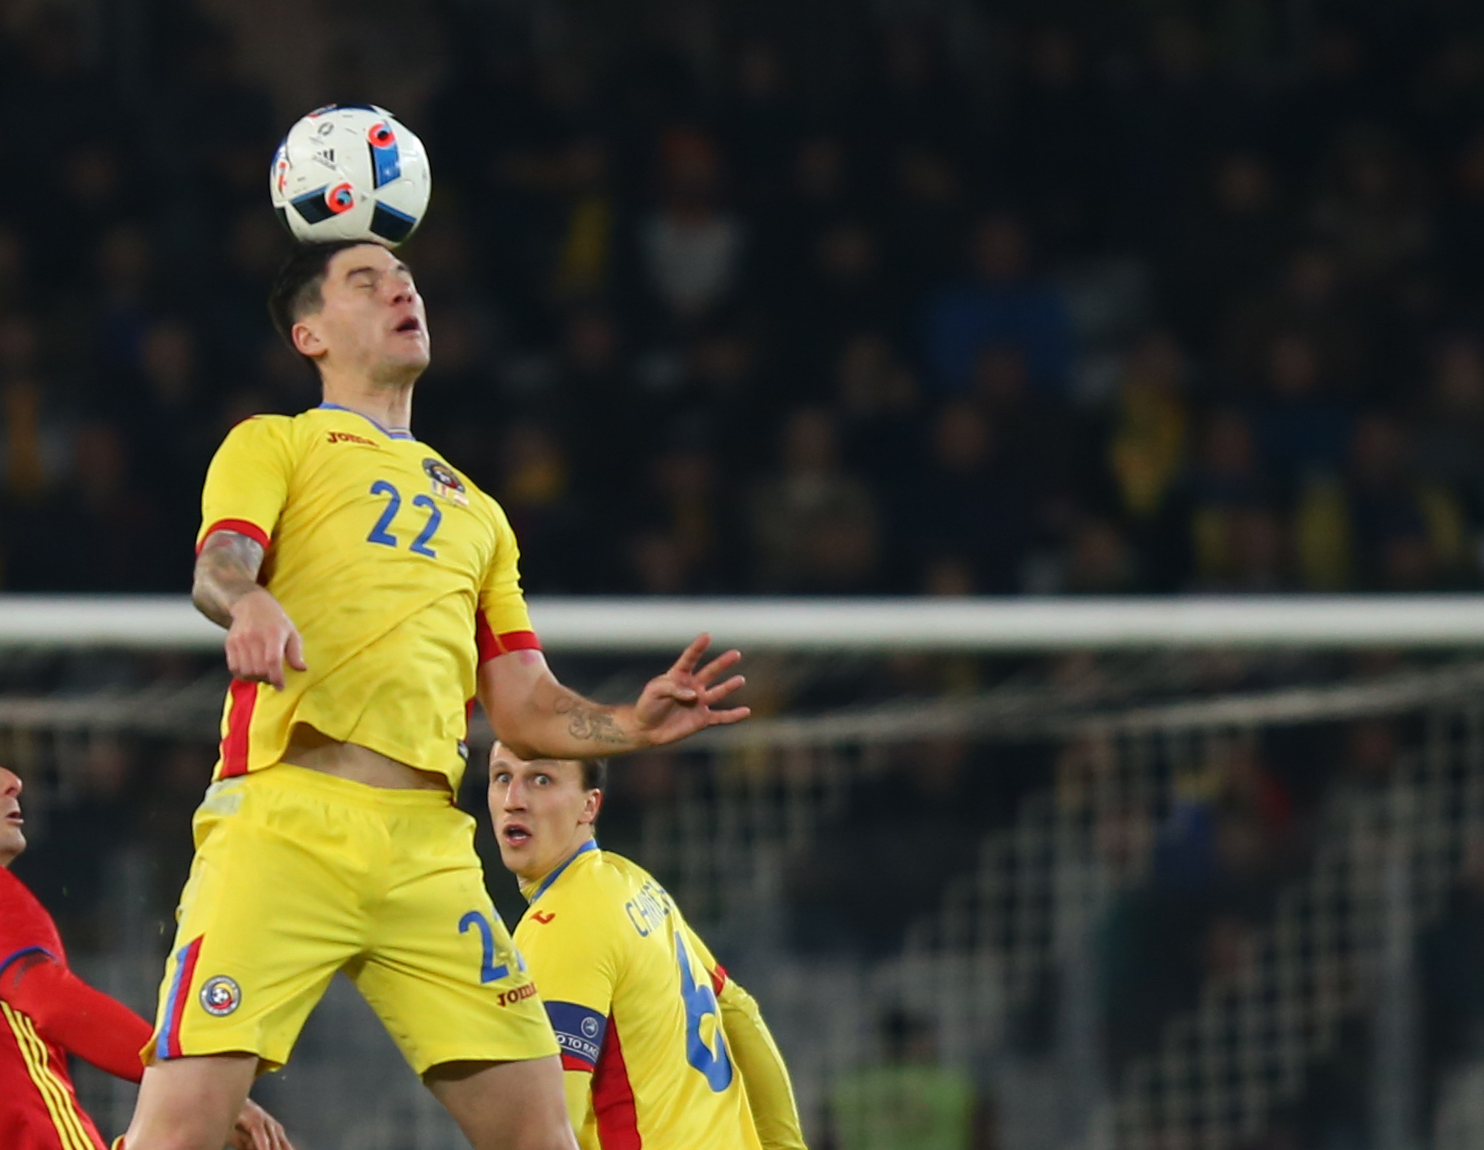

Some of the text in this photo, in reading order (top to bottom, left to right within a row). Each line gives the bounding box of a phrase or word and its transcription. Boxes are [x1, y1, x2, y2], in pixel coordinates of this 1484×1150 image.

[367, 479, 442, 559] 22
[568, 1037, 582, 1049] TO
[674, 930, 734, 1092] 6
